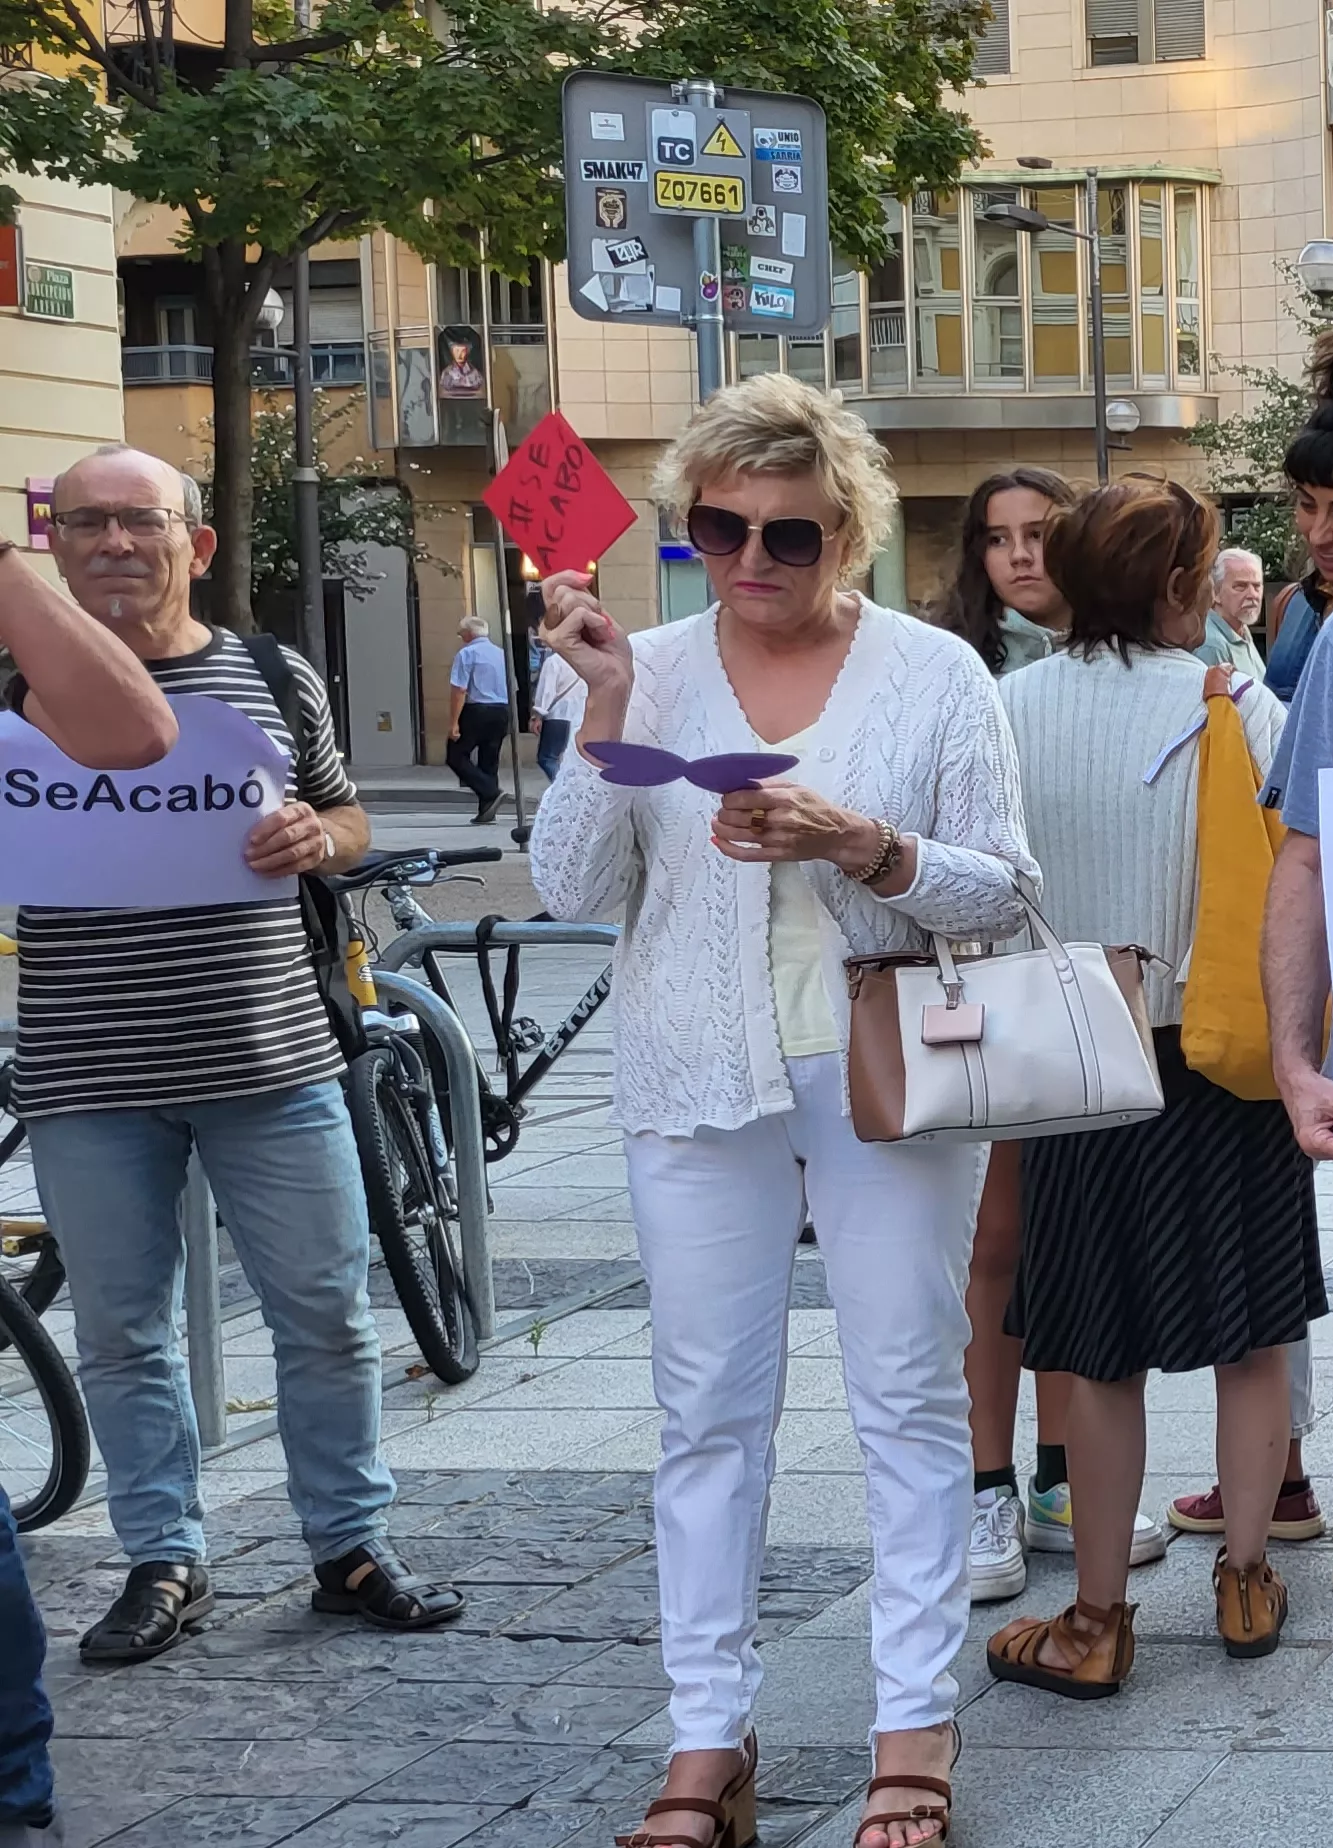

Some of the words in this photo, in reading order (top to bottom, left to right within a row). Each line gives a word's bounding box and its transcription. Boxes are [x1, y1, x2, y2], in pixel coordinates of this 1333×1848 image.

[661, 142, 690, 160] TC
[583, 161, 643, 180] SMAK47
[46, 270, 69, 284] Plaza
[0, 768, 264, 812] SeAcabó
